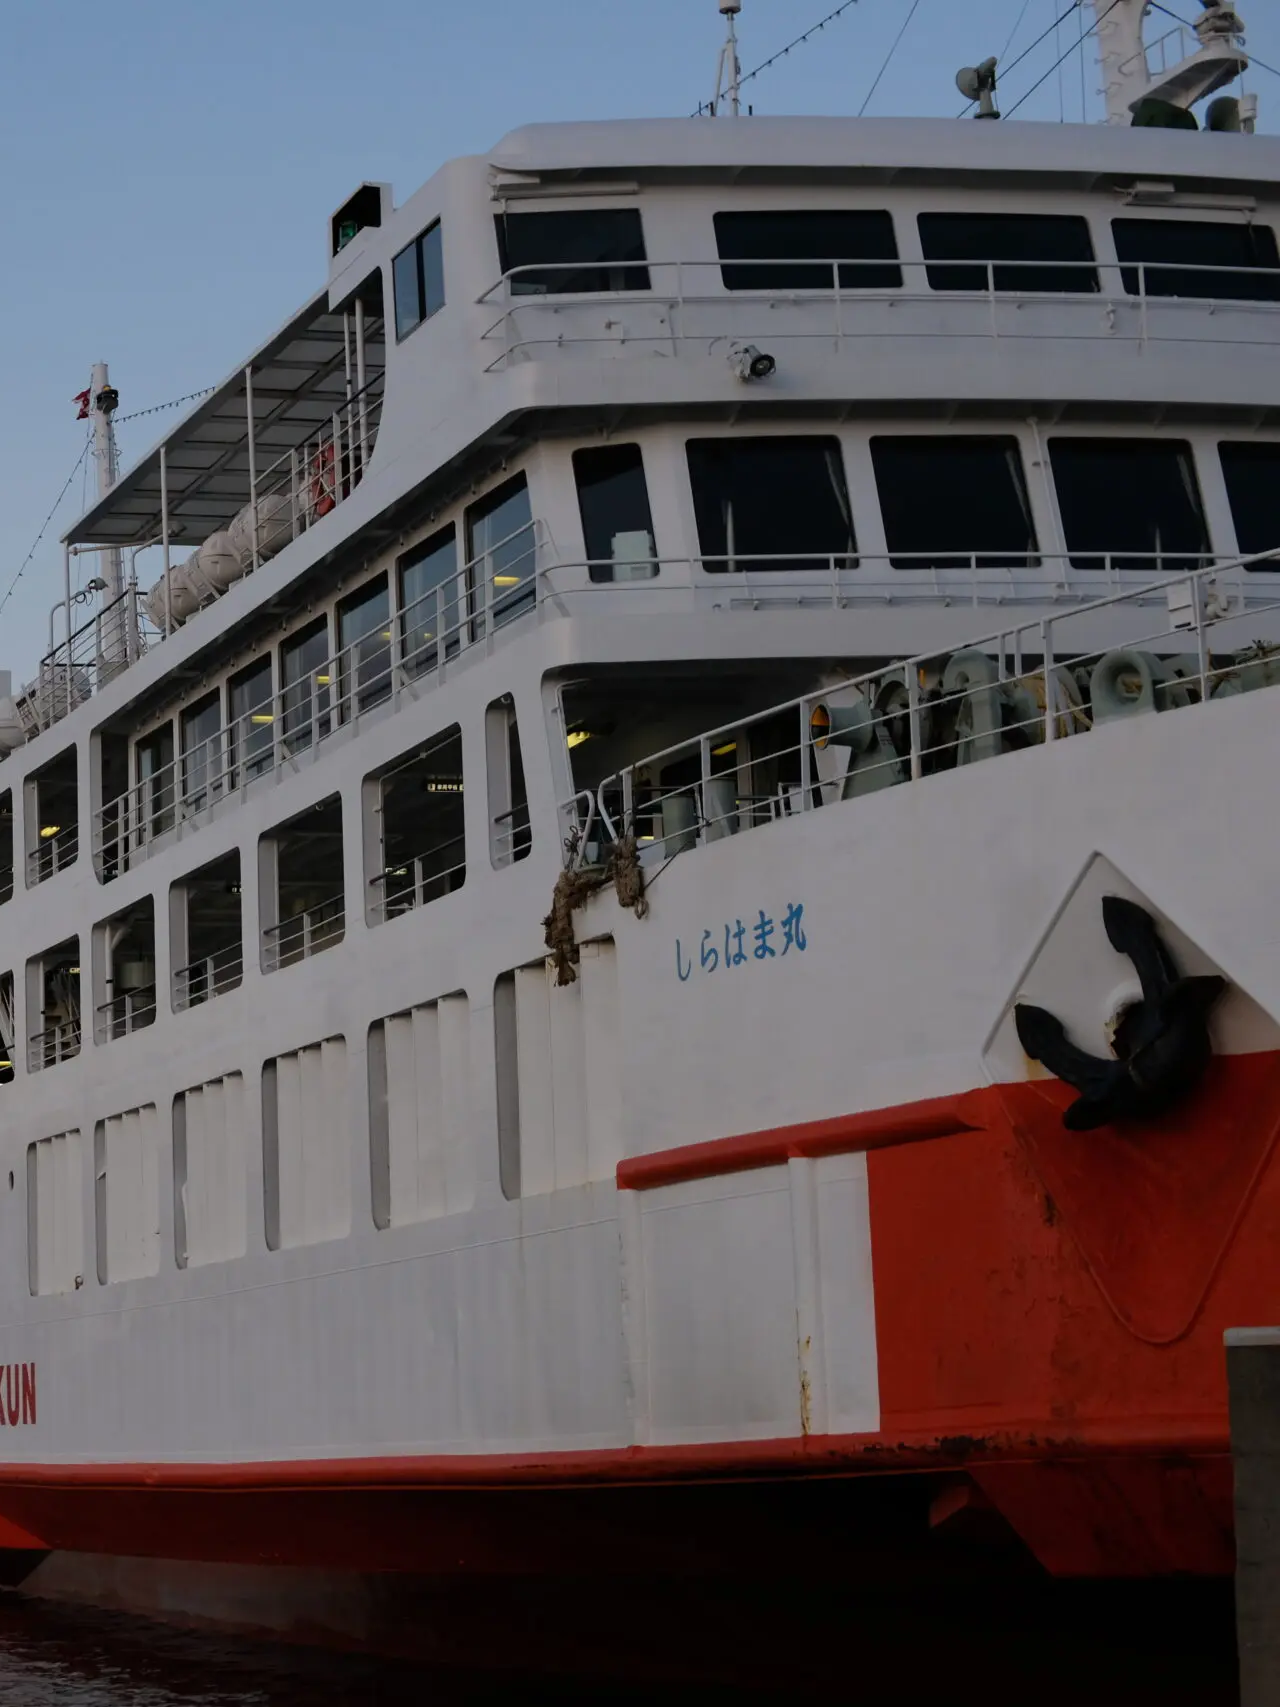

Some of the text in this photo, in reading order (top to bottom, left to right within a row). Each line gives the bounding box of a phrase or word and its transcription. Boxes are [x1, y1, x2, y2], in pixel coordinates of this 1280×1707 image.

[676, 902, 807, 981] しらはま丸
